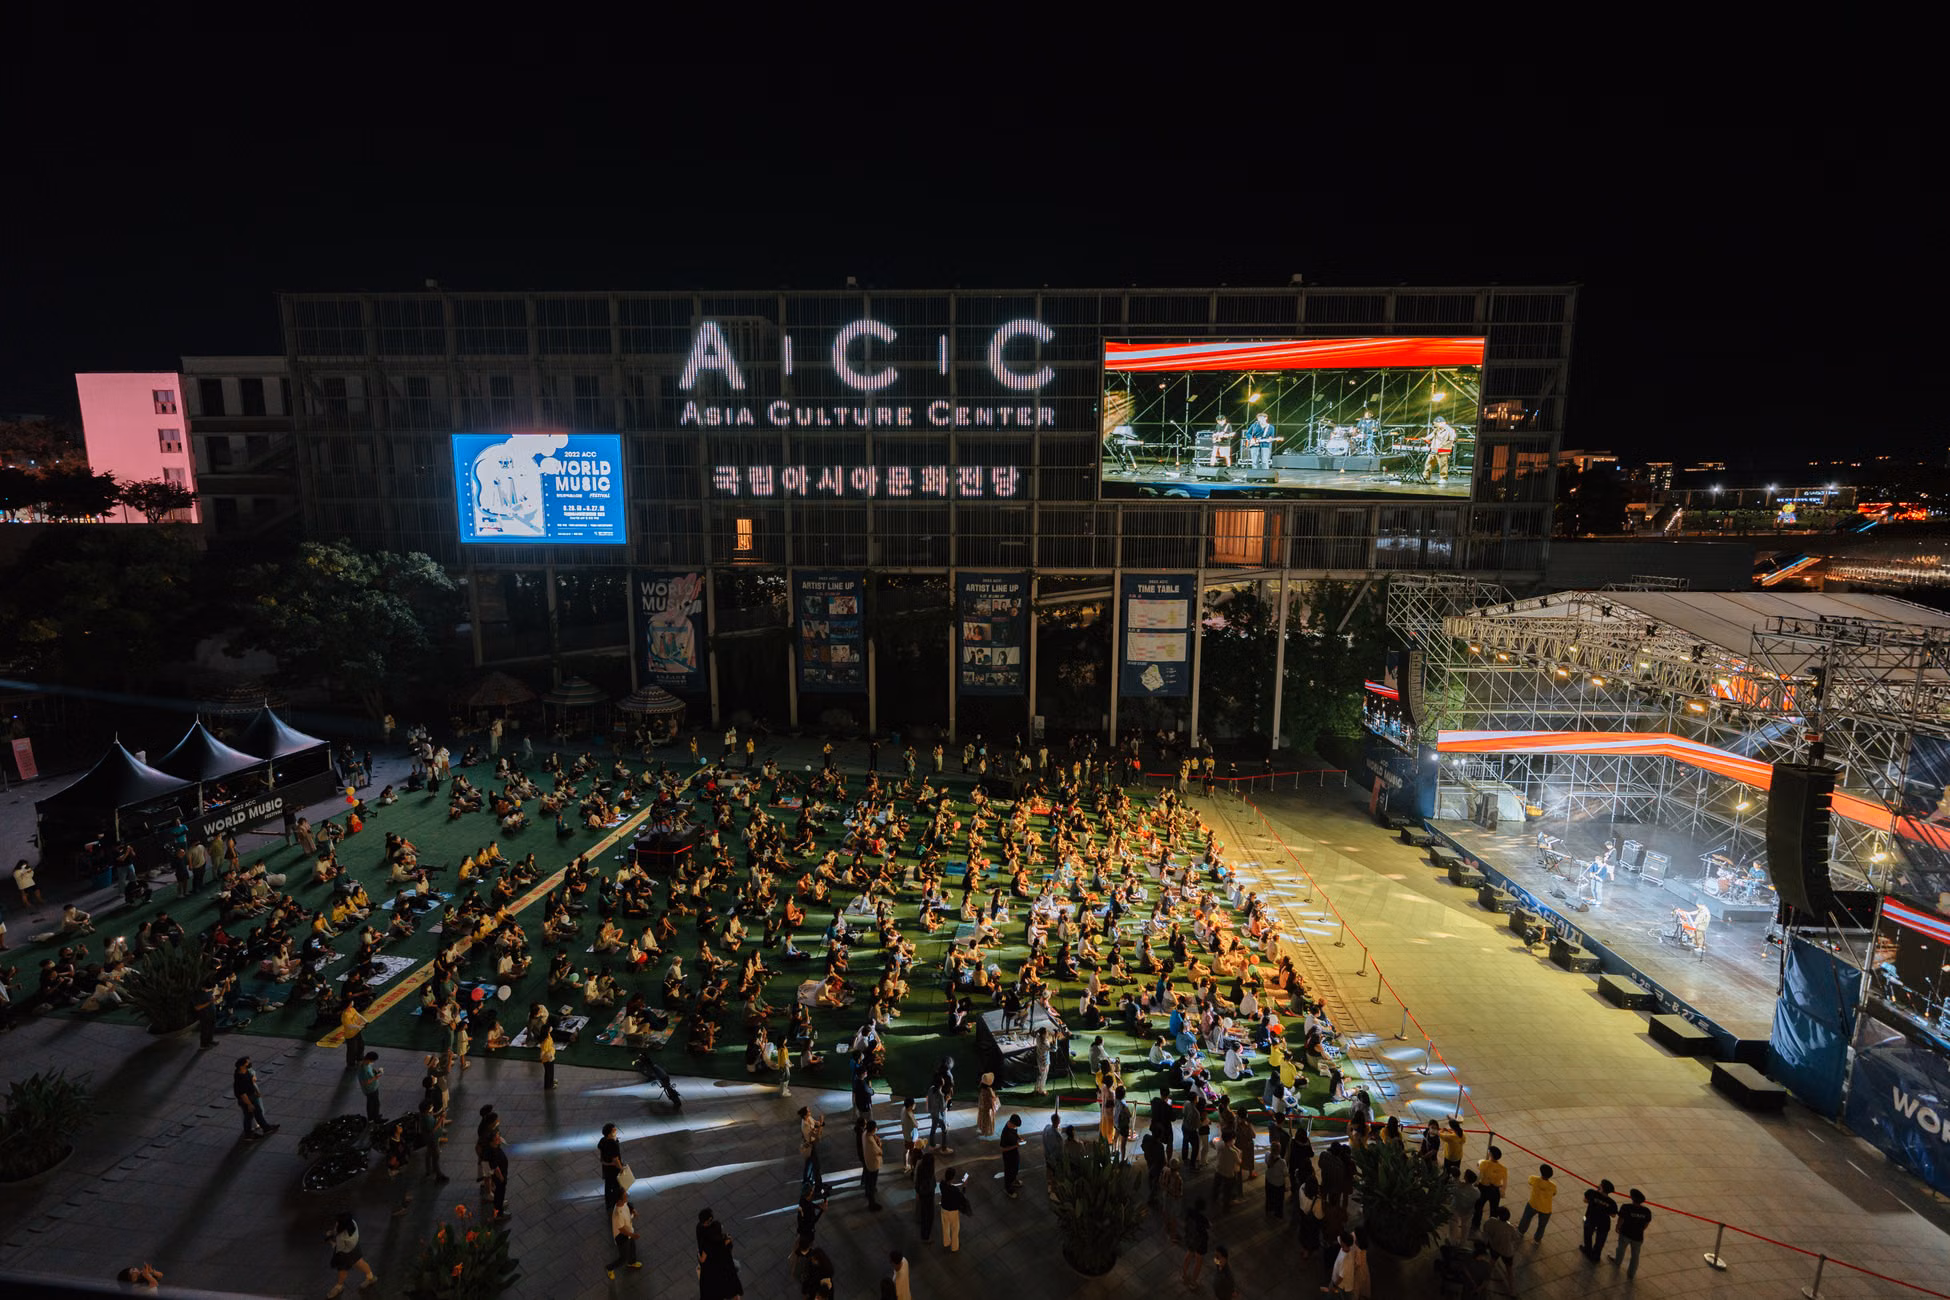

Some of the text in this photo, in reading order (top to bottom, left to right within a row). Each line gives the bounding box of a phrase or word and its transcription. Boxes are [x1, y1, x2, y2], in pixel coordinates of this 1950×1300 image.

[555, 460, 611, 476] WORLD
[555, 476, 611, 492] MUSIC
[802, 581, 855, 590] ARTIST LINE UP
[965, 583, 1019, 592] ARTIST LINE UP
[1137, 583, 1180, 593] TIME TABLE
[231, 799, 257, 813] 2022 ACC
[203, 797, 283, 836] WORLD MUSIC
